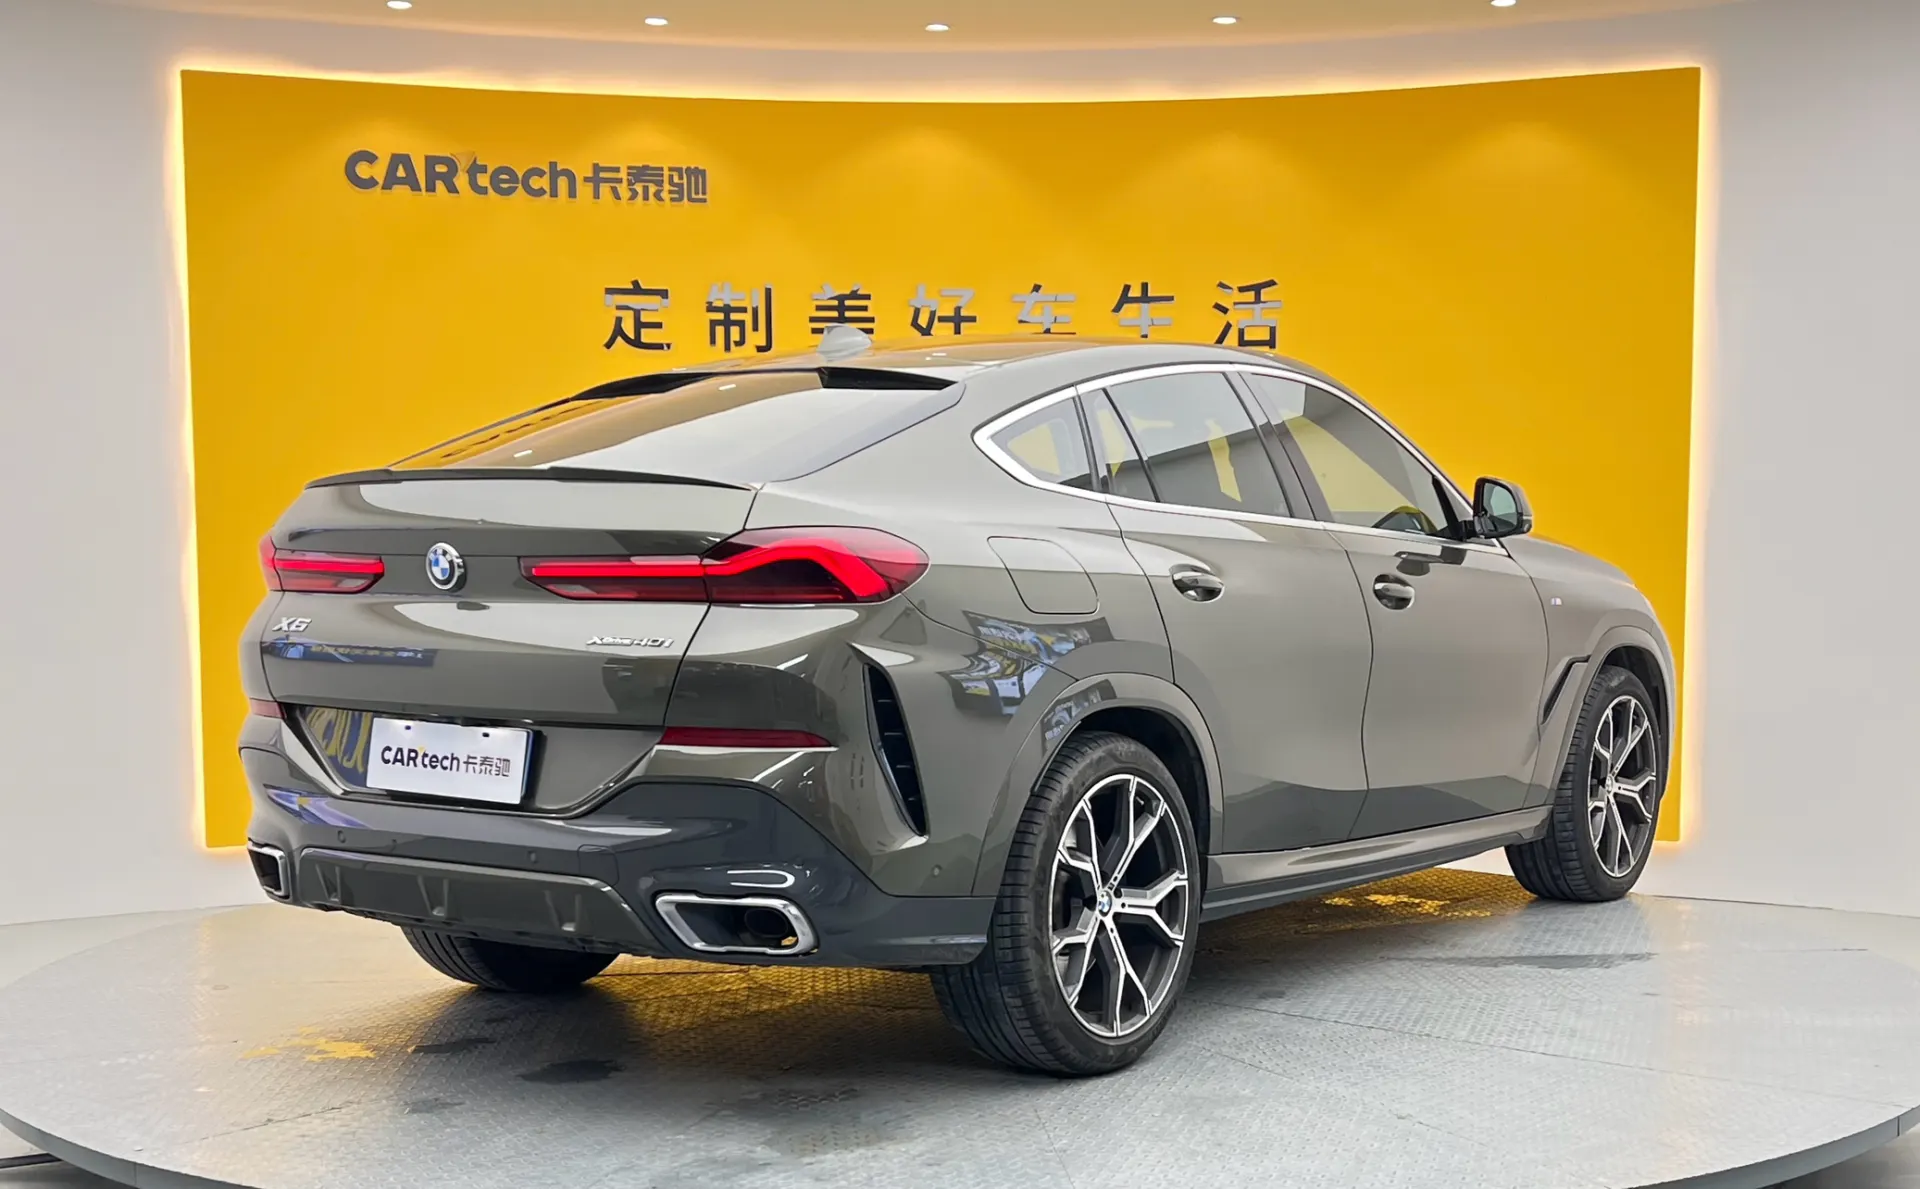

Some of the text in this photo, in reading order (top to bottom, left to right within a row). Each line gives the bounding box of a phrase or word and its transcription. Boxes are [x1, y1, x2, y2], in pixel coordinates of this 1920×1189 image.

[344, 149, 708, 203] CARtech 卡泰驰
[271, 617, 312, 632] X6
[380, 745, 511, 778] CARtech 卡泰驰
